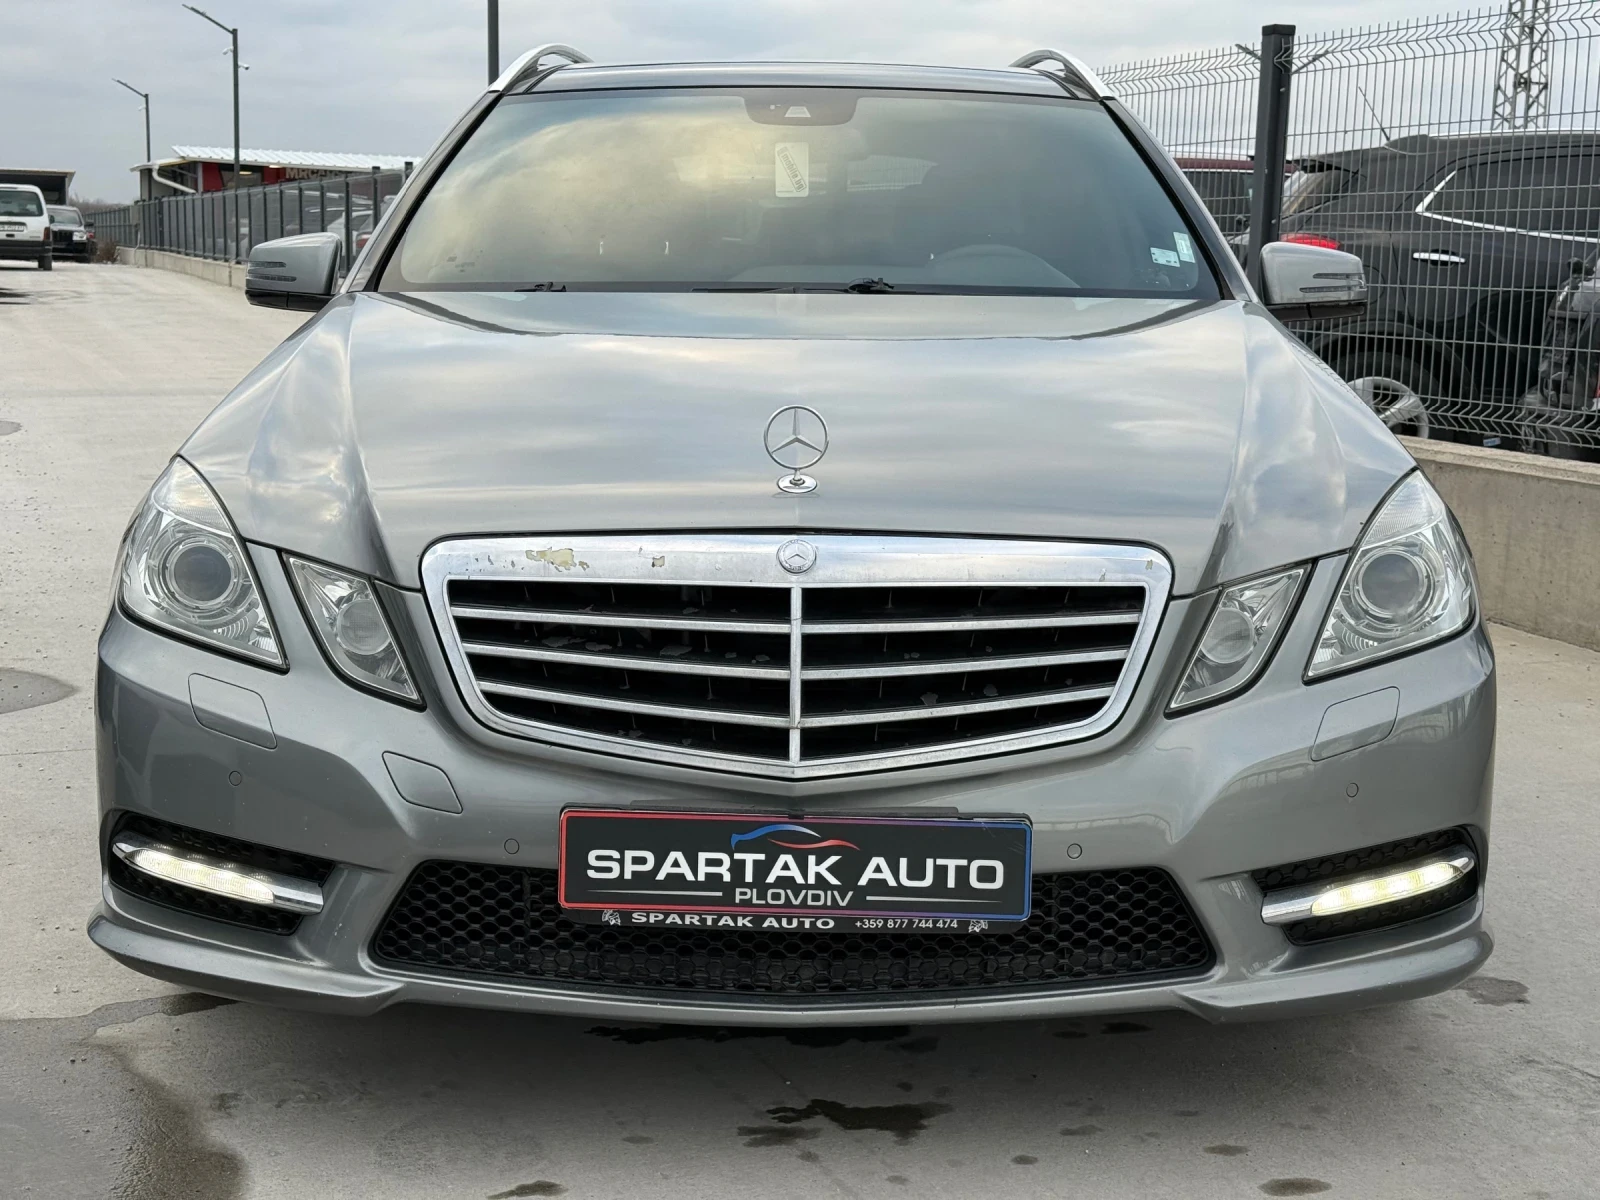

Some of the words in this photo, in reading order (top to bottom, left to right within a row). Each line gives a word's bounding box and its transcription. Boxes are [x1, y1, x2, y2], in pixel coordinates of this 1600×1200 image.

[780, 153, 804, 190] mobile.bg
[586, 849, 843, 886] SPARTAK
[857, 856, 1004, 890] AUTO
[735, 887, 854, 907] PLOVDIV
[631, 912, 754, 928] SPARTAK
[762, 916, 835, 929] AUTO
[855, 918, 884, 929] +359
[887, 919, 908, 928] 877
[912, 919, 933, 929] 744
[936, 919, 958, 929] 474
